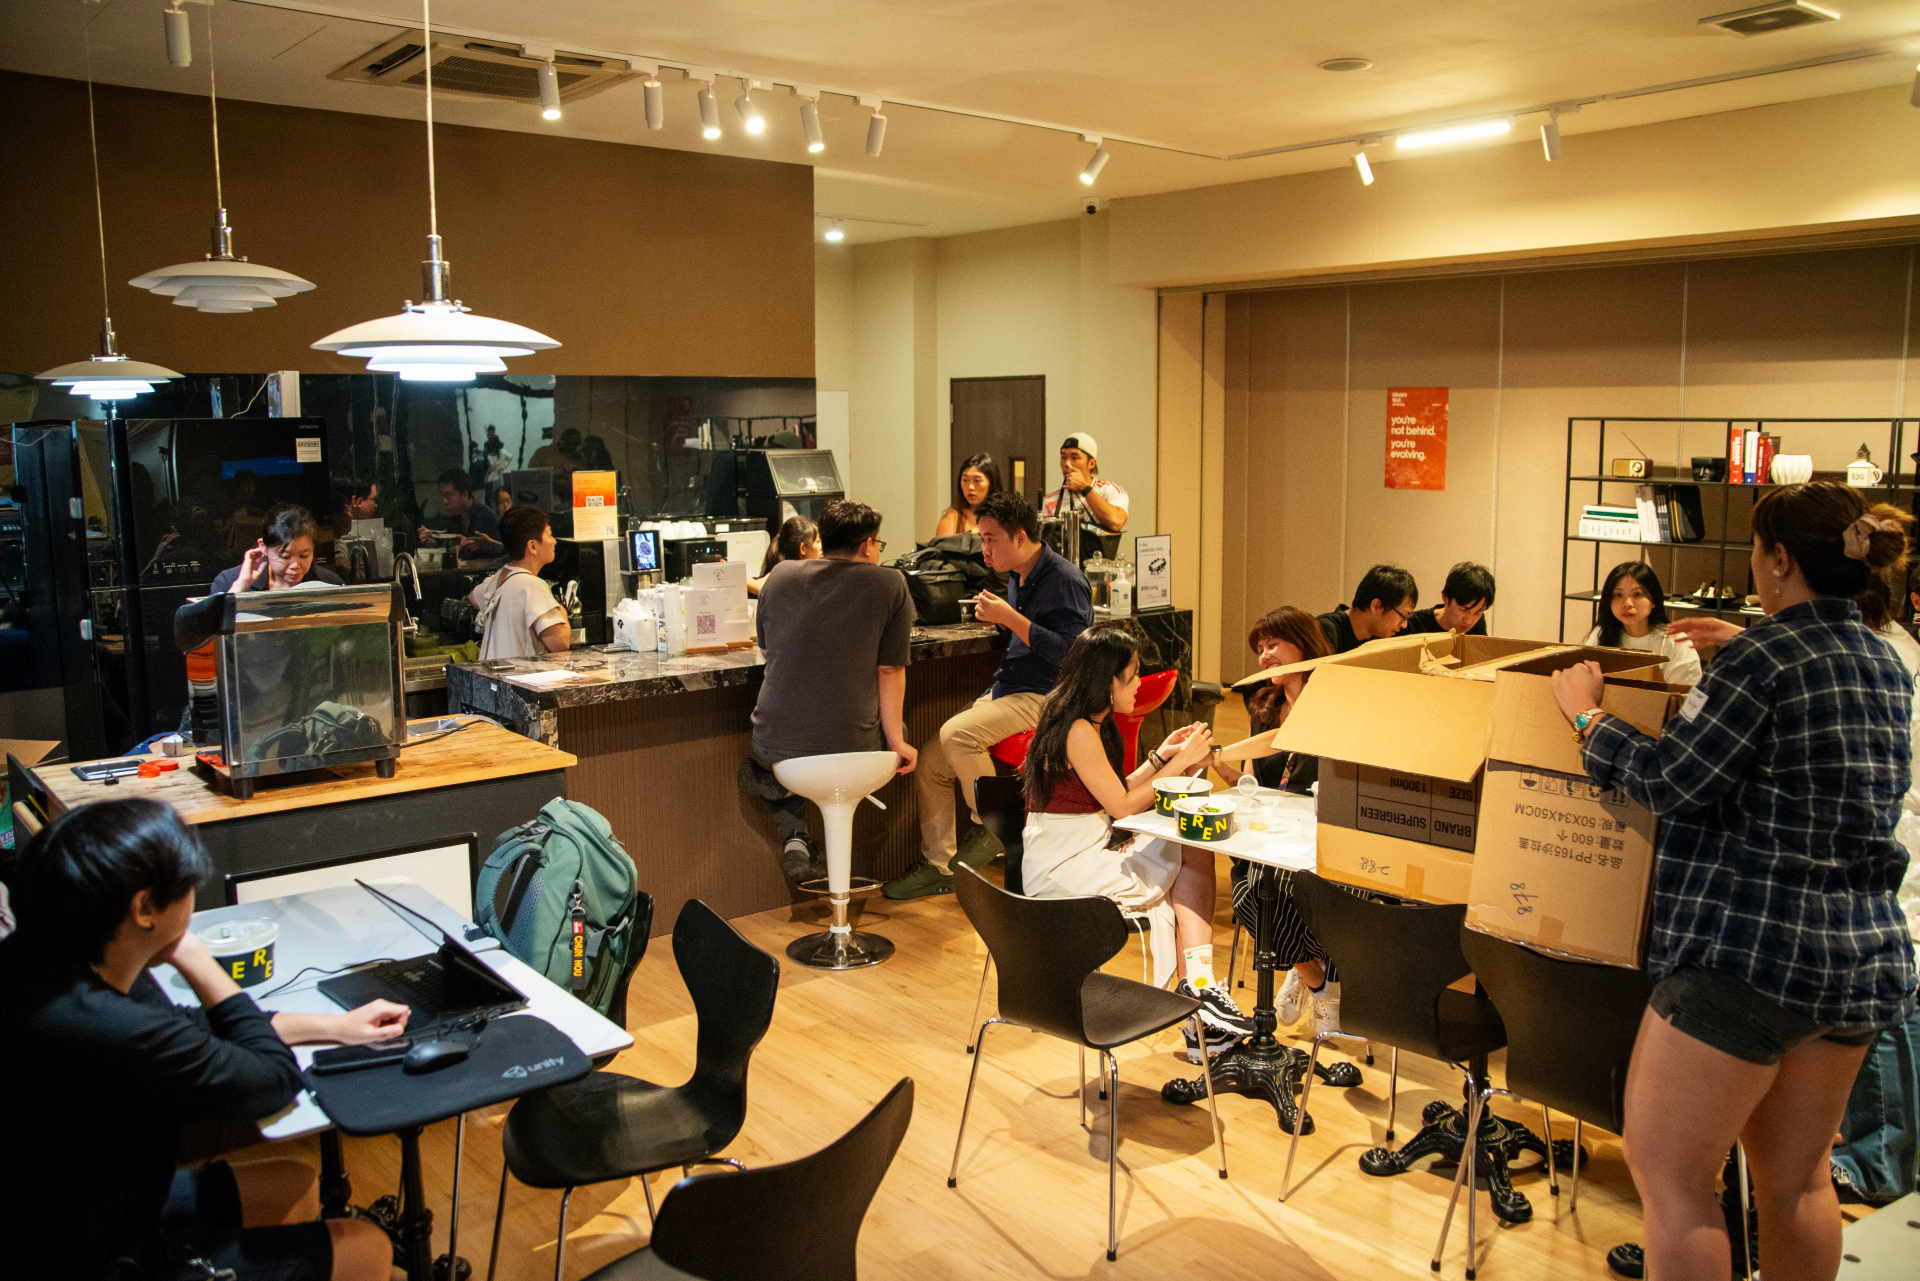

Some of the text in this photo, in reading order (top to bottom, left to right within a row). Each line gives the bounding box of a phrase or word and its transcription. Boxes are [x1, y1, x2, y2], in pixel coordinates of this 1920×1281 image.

[1391, 416, 1416, 426] you're
[1391, 425, 1436, 435] not behind.
[1391, 439, 1416, 449] you're
[1391, 450, 1426, 461] evolving.
[1390, 776, 1427, 793] 1300ml
[1449, 786, 1474, 801] SIZE
[1360, 806, 1426, 830] SUPERGREEN
[1434, 820, 1472, 838] BRAND
[1359, 856, 1391, 876] 288
[573, 935, 584, 977] CHUN HOU
[526, 1055, 564, 1072] unity
